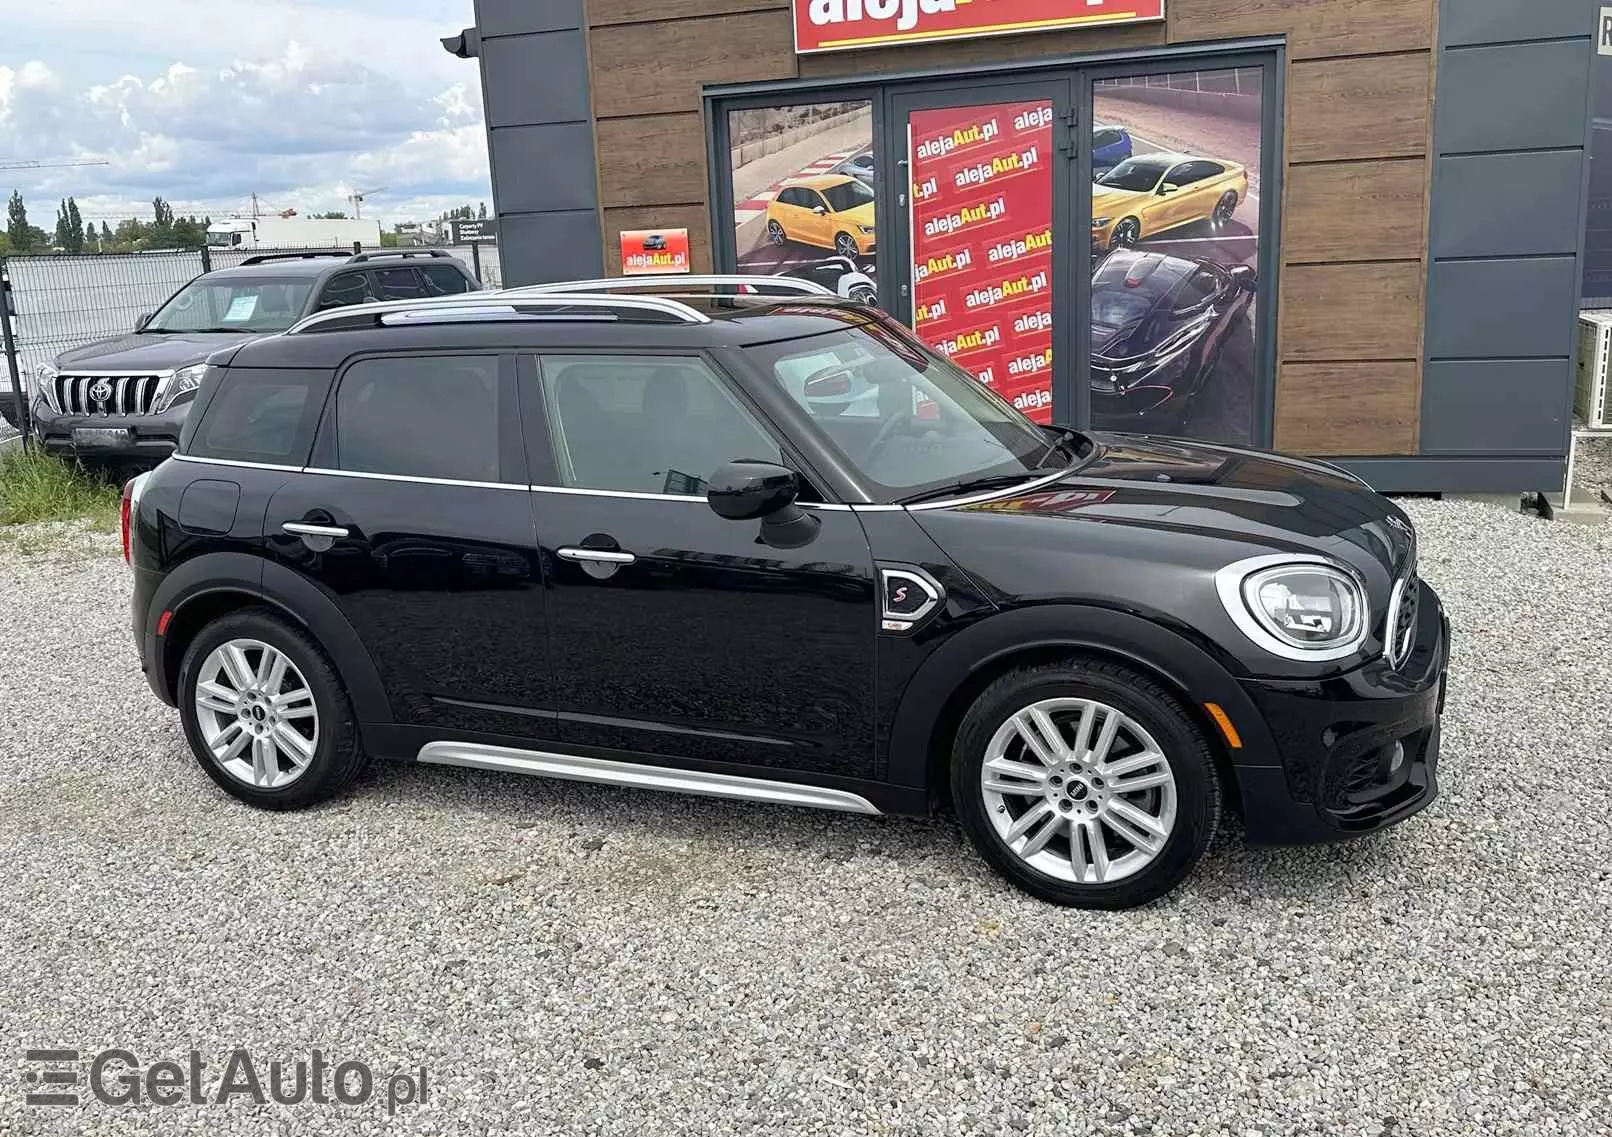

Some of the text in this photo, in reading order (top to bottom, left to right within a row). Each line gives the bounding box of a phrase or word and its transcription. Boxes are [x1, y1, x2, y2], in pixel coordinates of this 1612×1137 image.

[917, 119, 998, 158] alejaAut.pl
[955, 147, 1037, 185] alejaAut.pl
[925, 198, 1005, 235] alejaAut.pl
[627, 252, 685, 267] alejaAut.pl
[966, 272, 1047, 306] alejaAut.pl
